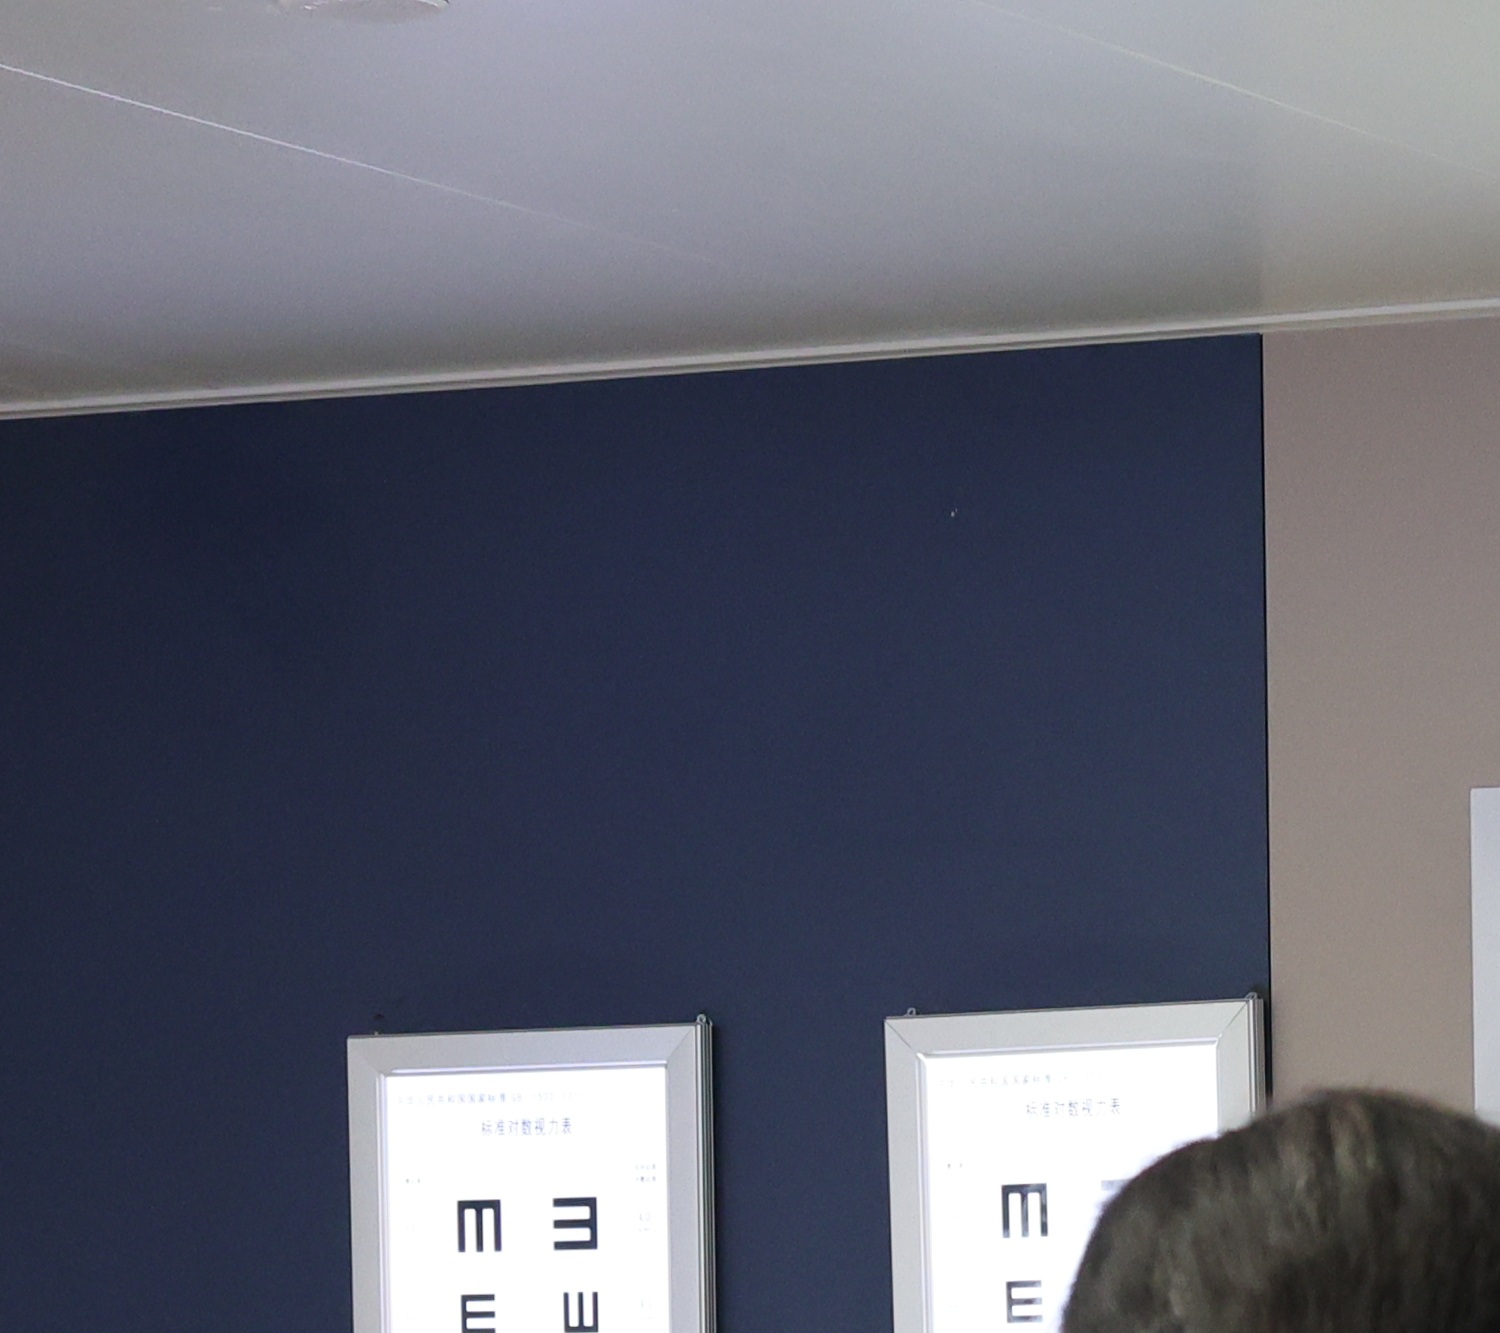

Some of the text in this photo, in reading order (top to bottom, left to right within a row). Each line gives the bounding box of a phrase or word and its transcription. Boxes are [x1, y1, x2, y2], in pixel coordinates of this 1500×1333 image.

[480, 1117, 573, 1137] 标准对数视力表
